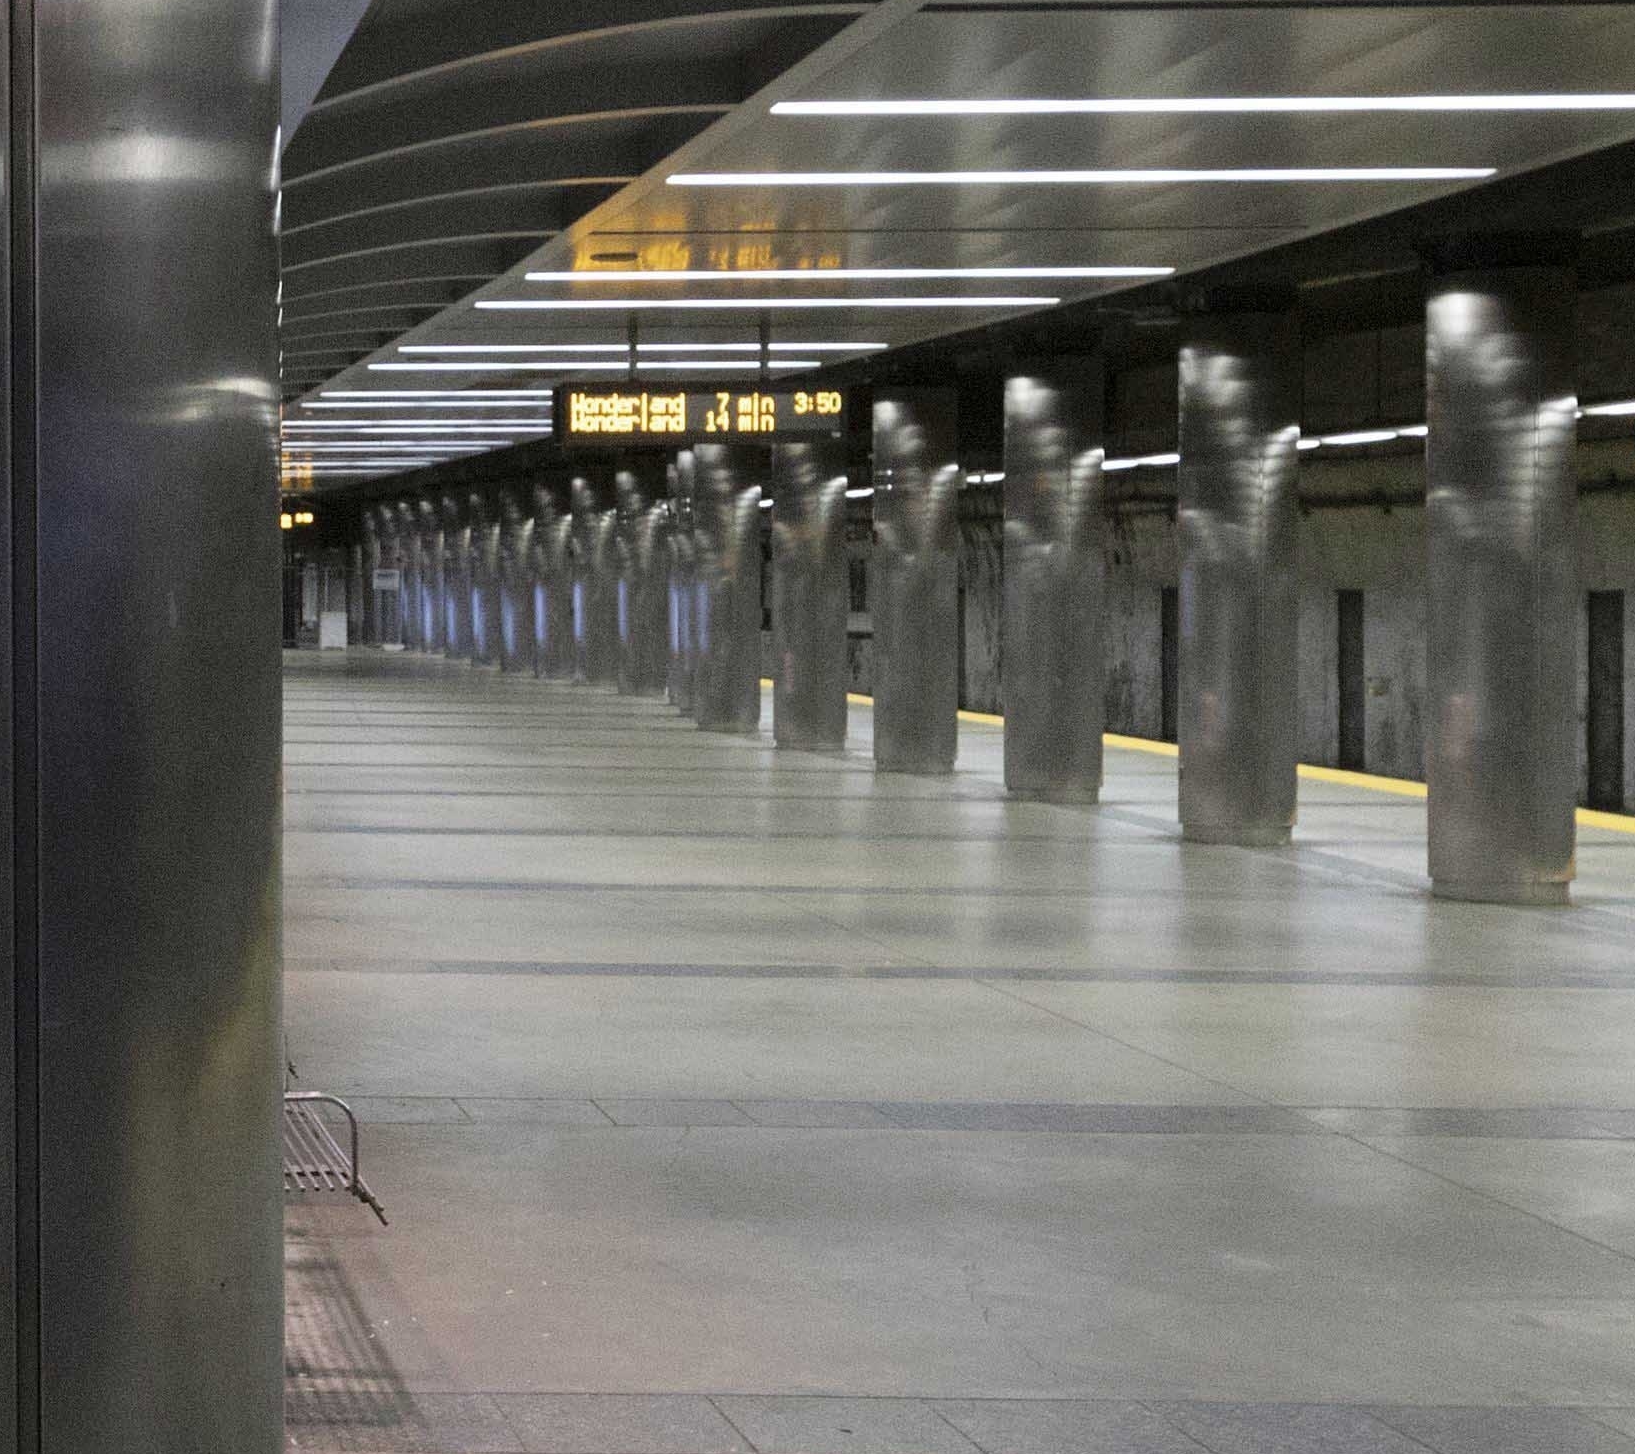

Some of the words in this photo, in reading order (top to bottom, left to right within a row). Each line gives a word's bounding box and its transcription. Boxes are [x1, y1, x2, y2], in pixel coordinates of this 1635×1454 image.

[571, 392, 685, 414] Wonderland
[716, 392, 729, 414] 7
[738, 392, 774, 414] min
[794, 392, 842, 414] 3:50
[571, 413, 685, 432] Wonderland
[705, 411, 729, 432] 14
[738, 412, 774, 432] min
